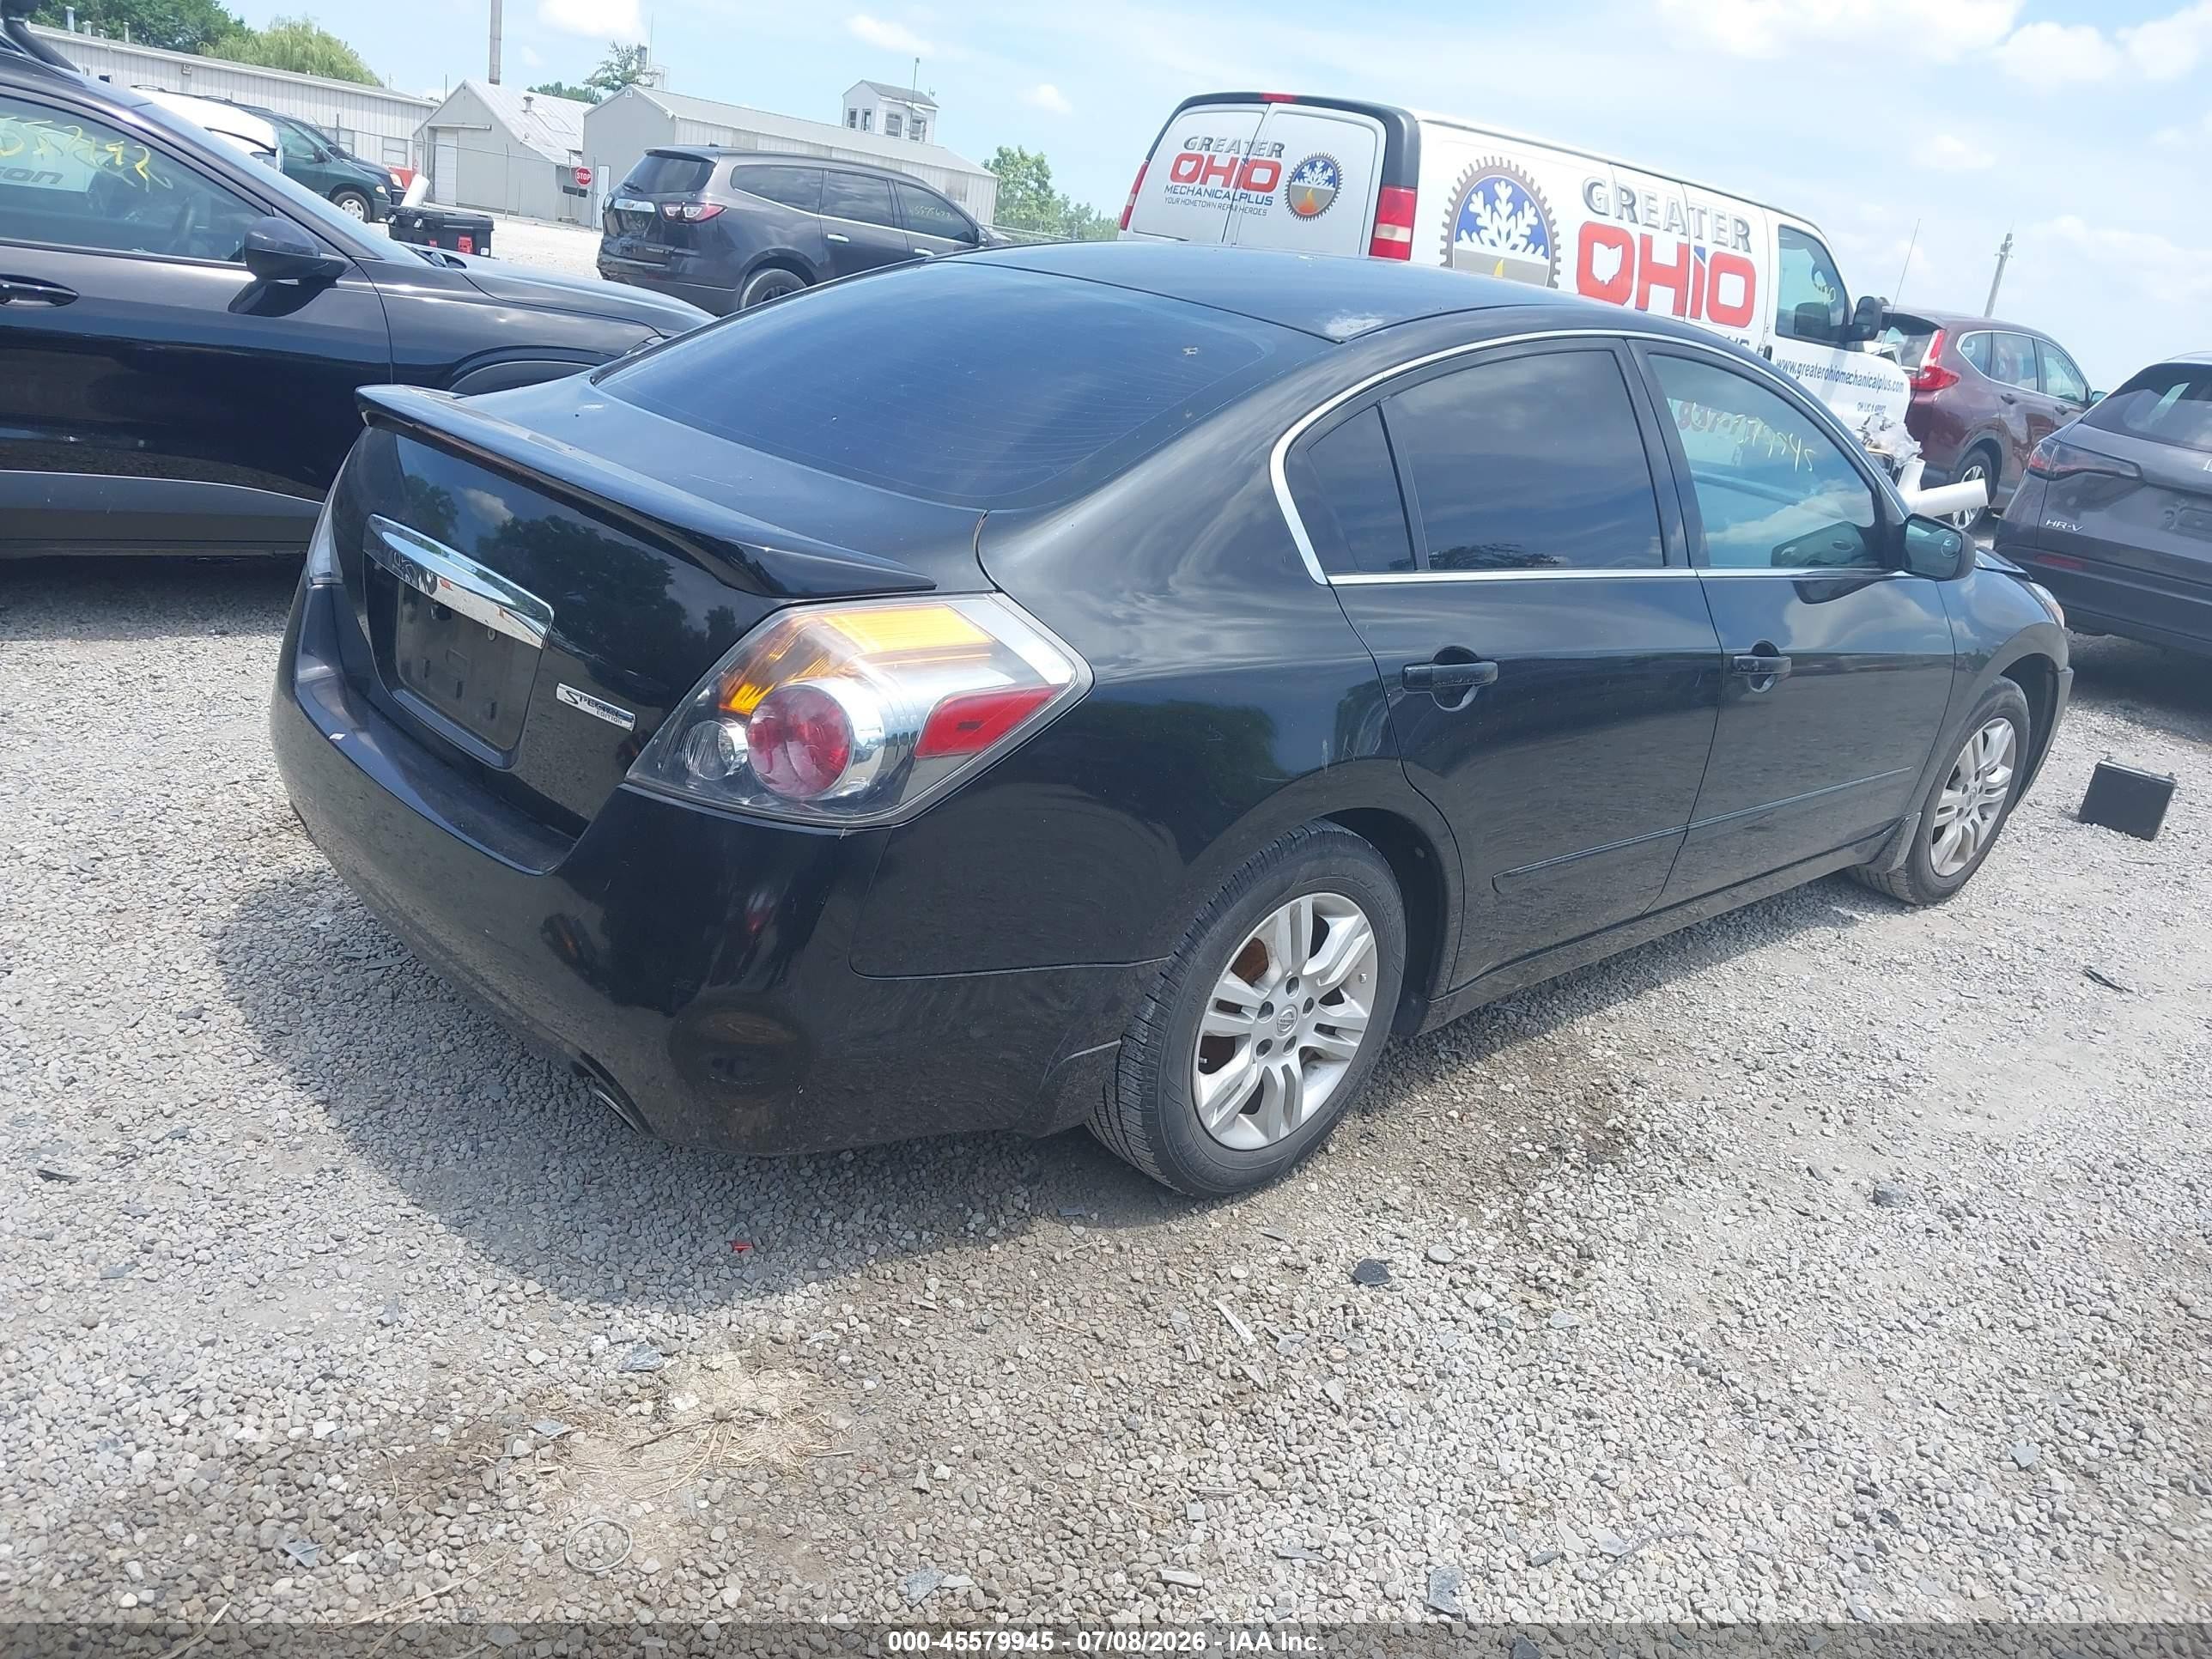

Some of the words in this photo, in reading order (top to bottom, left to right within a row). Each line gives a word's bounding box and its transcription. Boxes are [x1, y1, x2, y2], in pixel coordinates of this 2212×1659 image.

[1183, 135, 1285, 159] GREATER
[576, 172, 592, 181] STOP
[1170, 152, 1283, 193] OHIO
[1164, 197, 1181, 205] YOUR
[1181, 198, 1216, 210] HOMETOWN
[1239, 205, 1267, 216] HEROES
[1582, 176, 1753, 254] GREATER
[1577, 220, 1756, 328] OHIO
[2045, 519, 2084, 532] HR-V
[596, 708, 623, 725] EDITION
